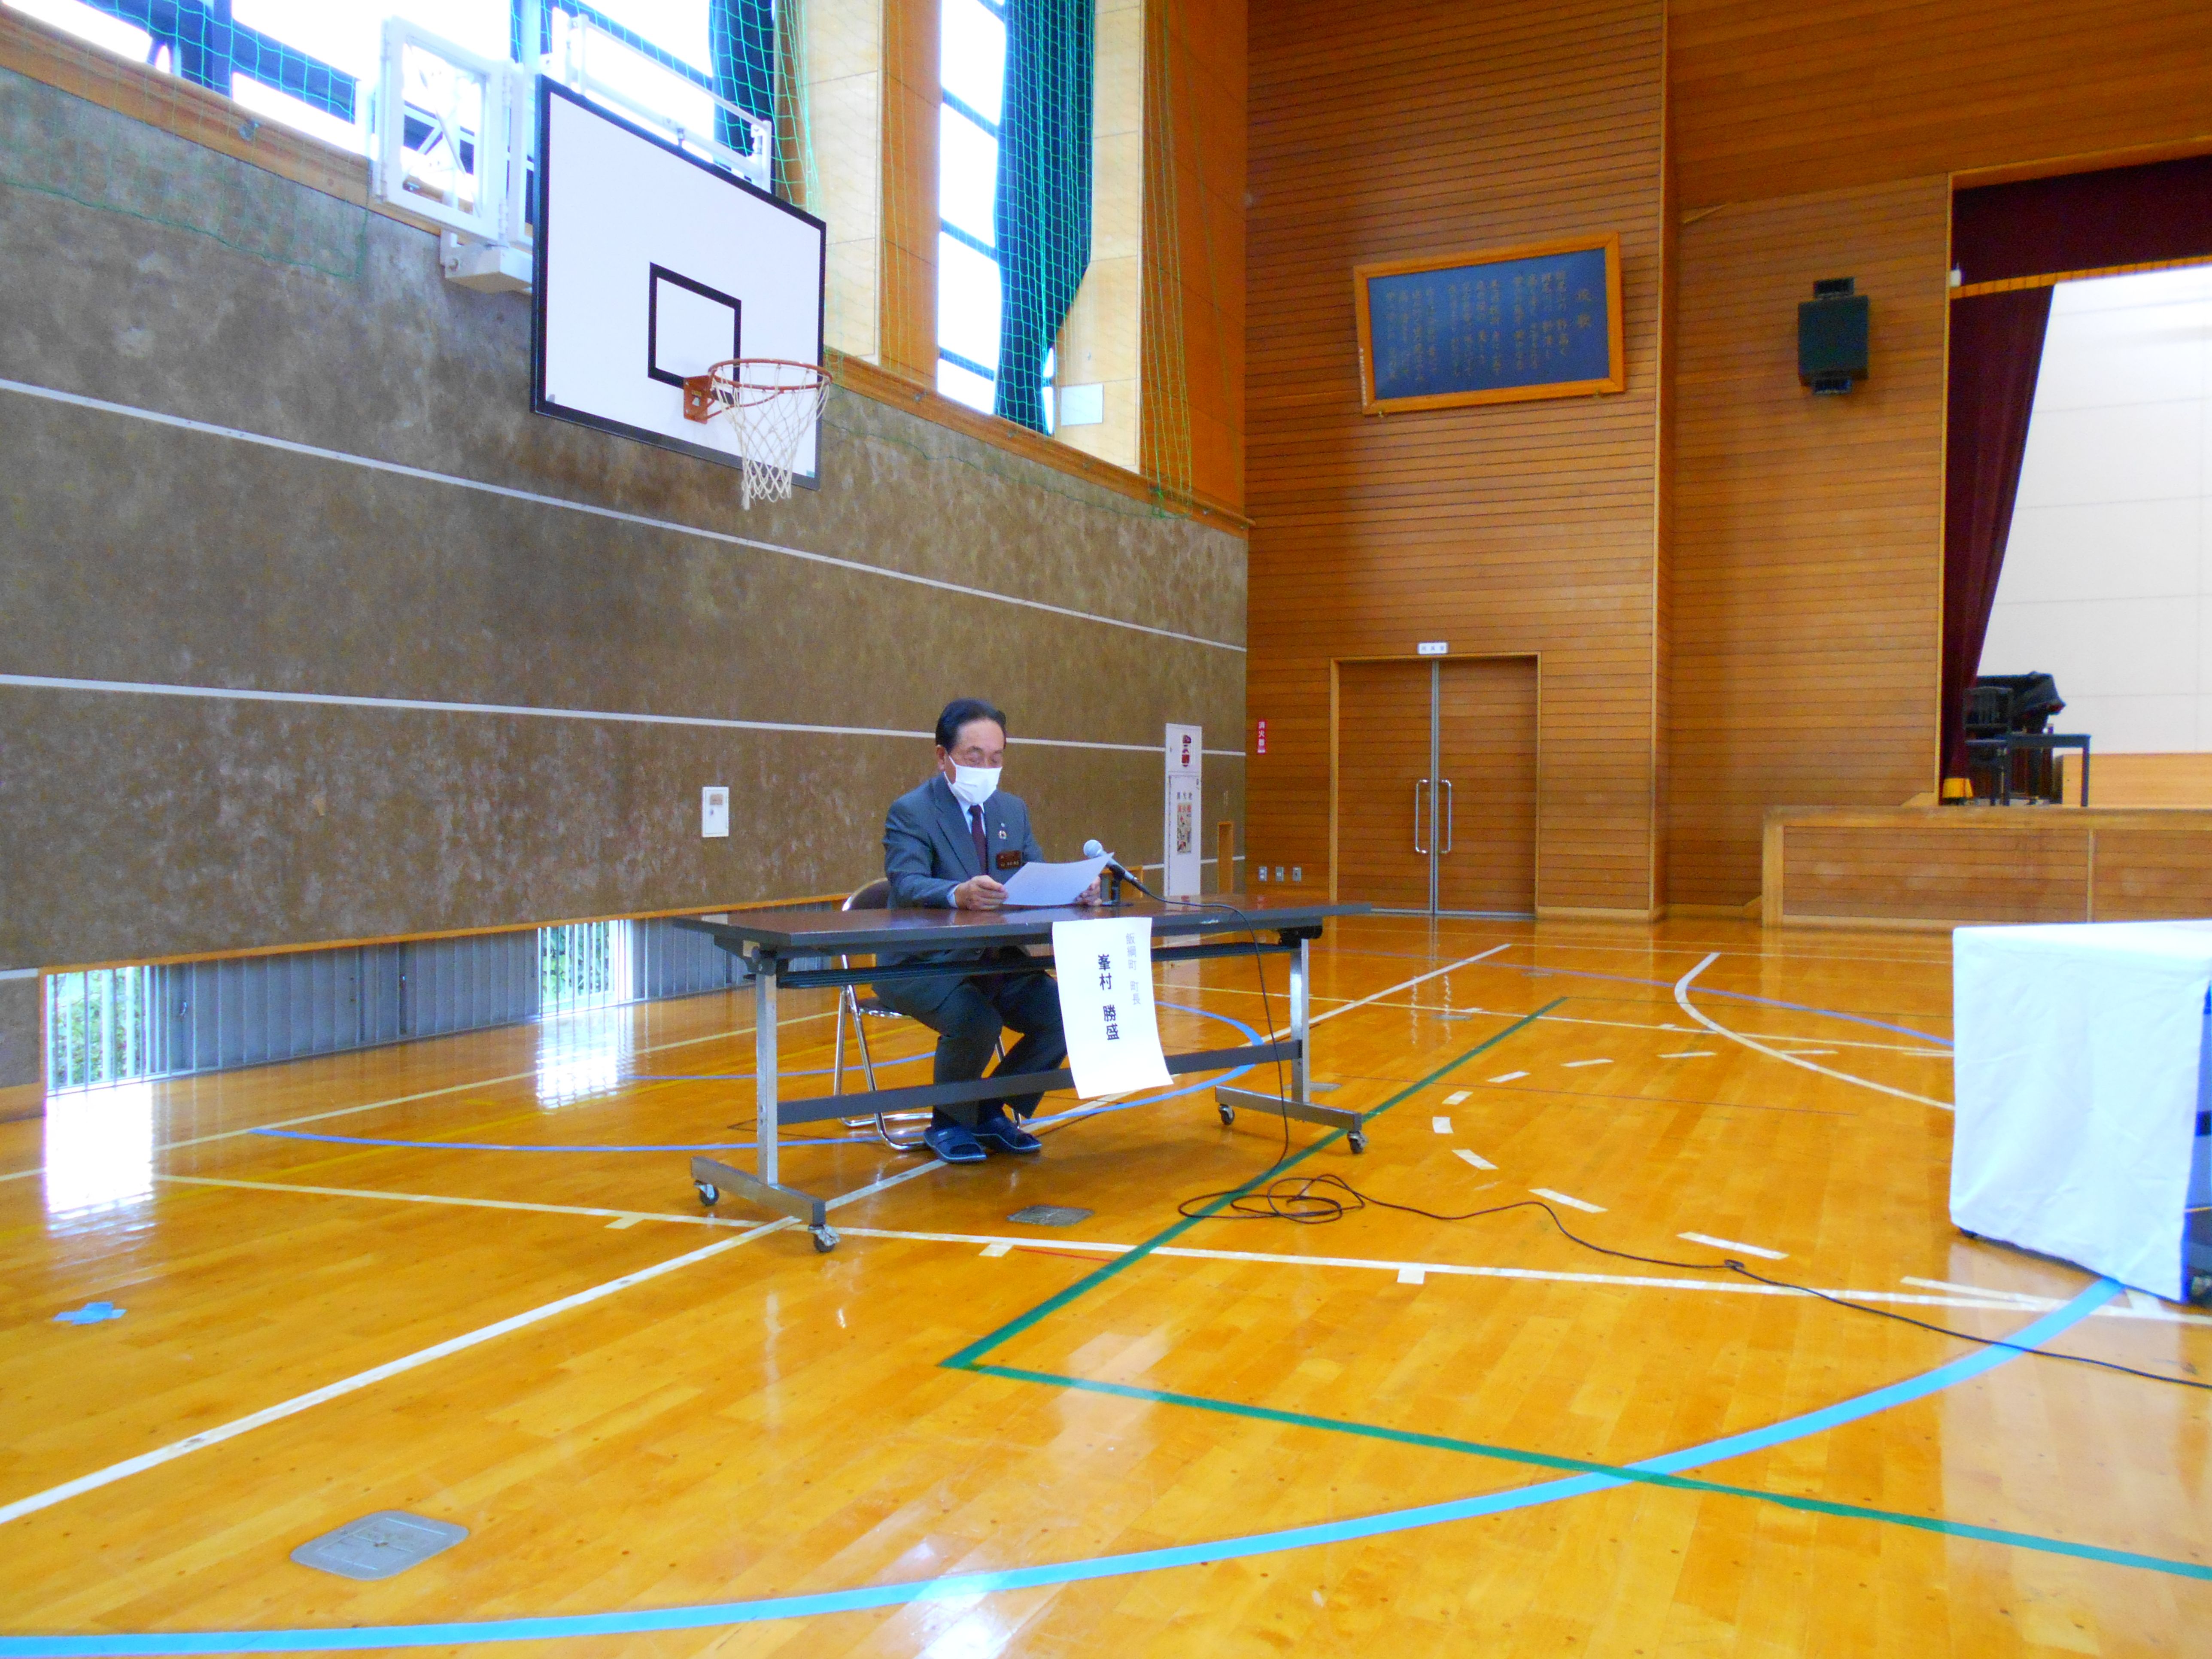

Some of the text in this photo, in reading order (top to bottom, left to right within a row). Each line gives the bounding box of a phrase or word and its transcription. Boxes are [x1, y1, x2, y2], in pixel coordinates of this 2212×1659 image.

[1098, 954, 1120, 1041] 峯村 勝盛
[1130, 981, 1141, 1005] 町長
